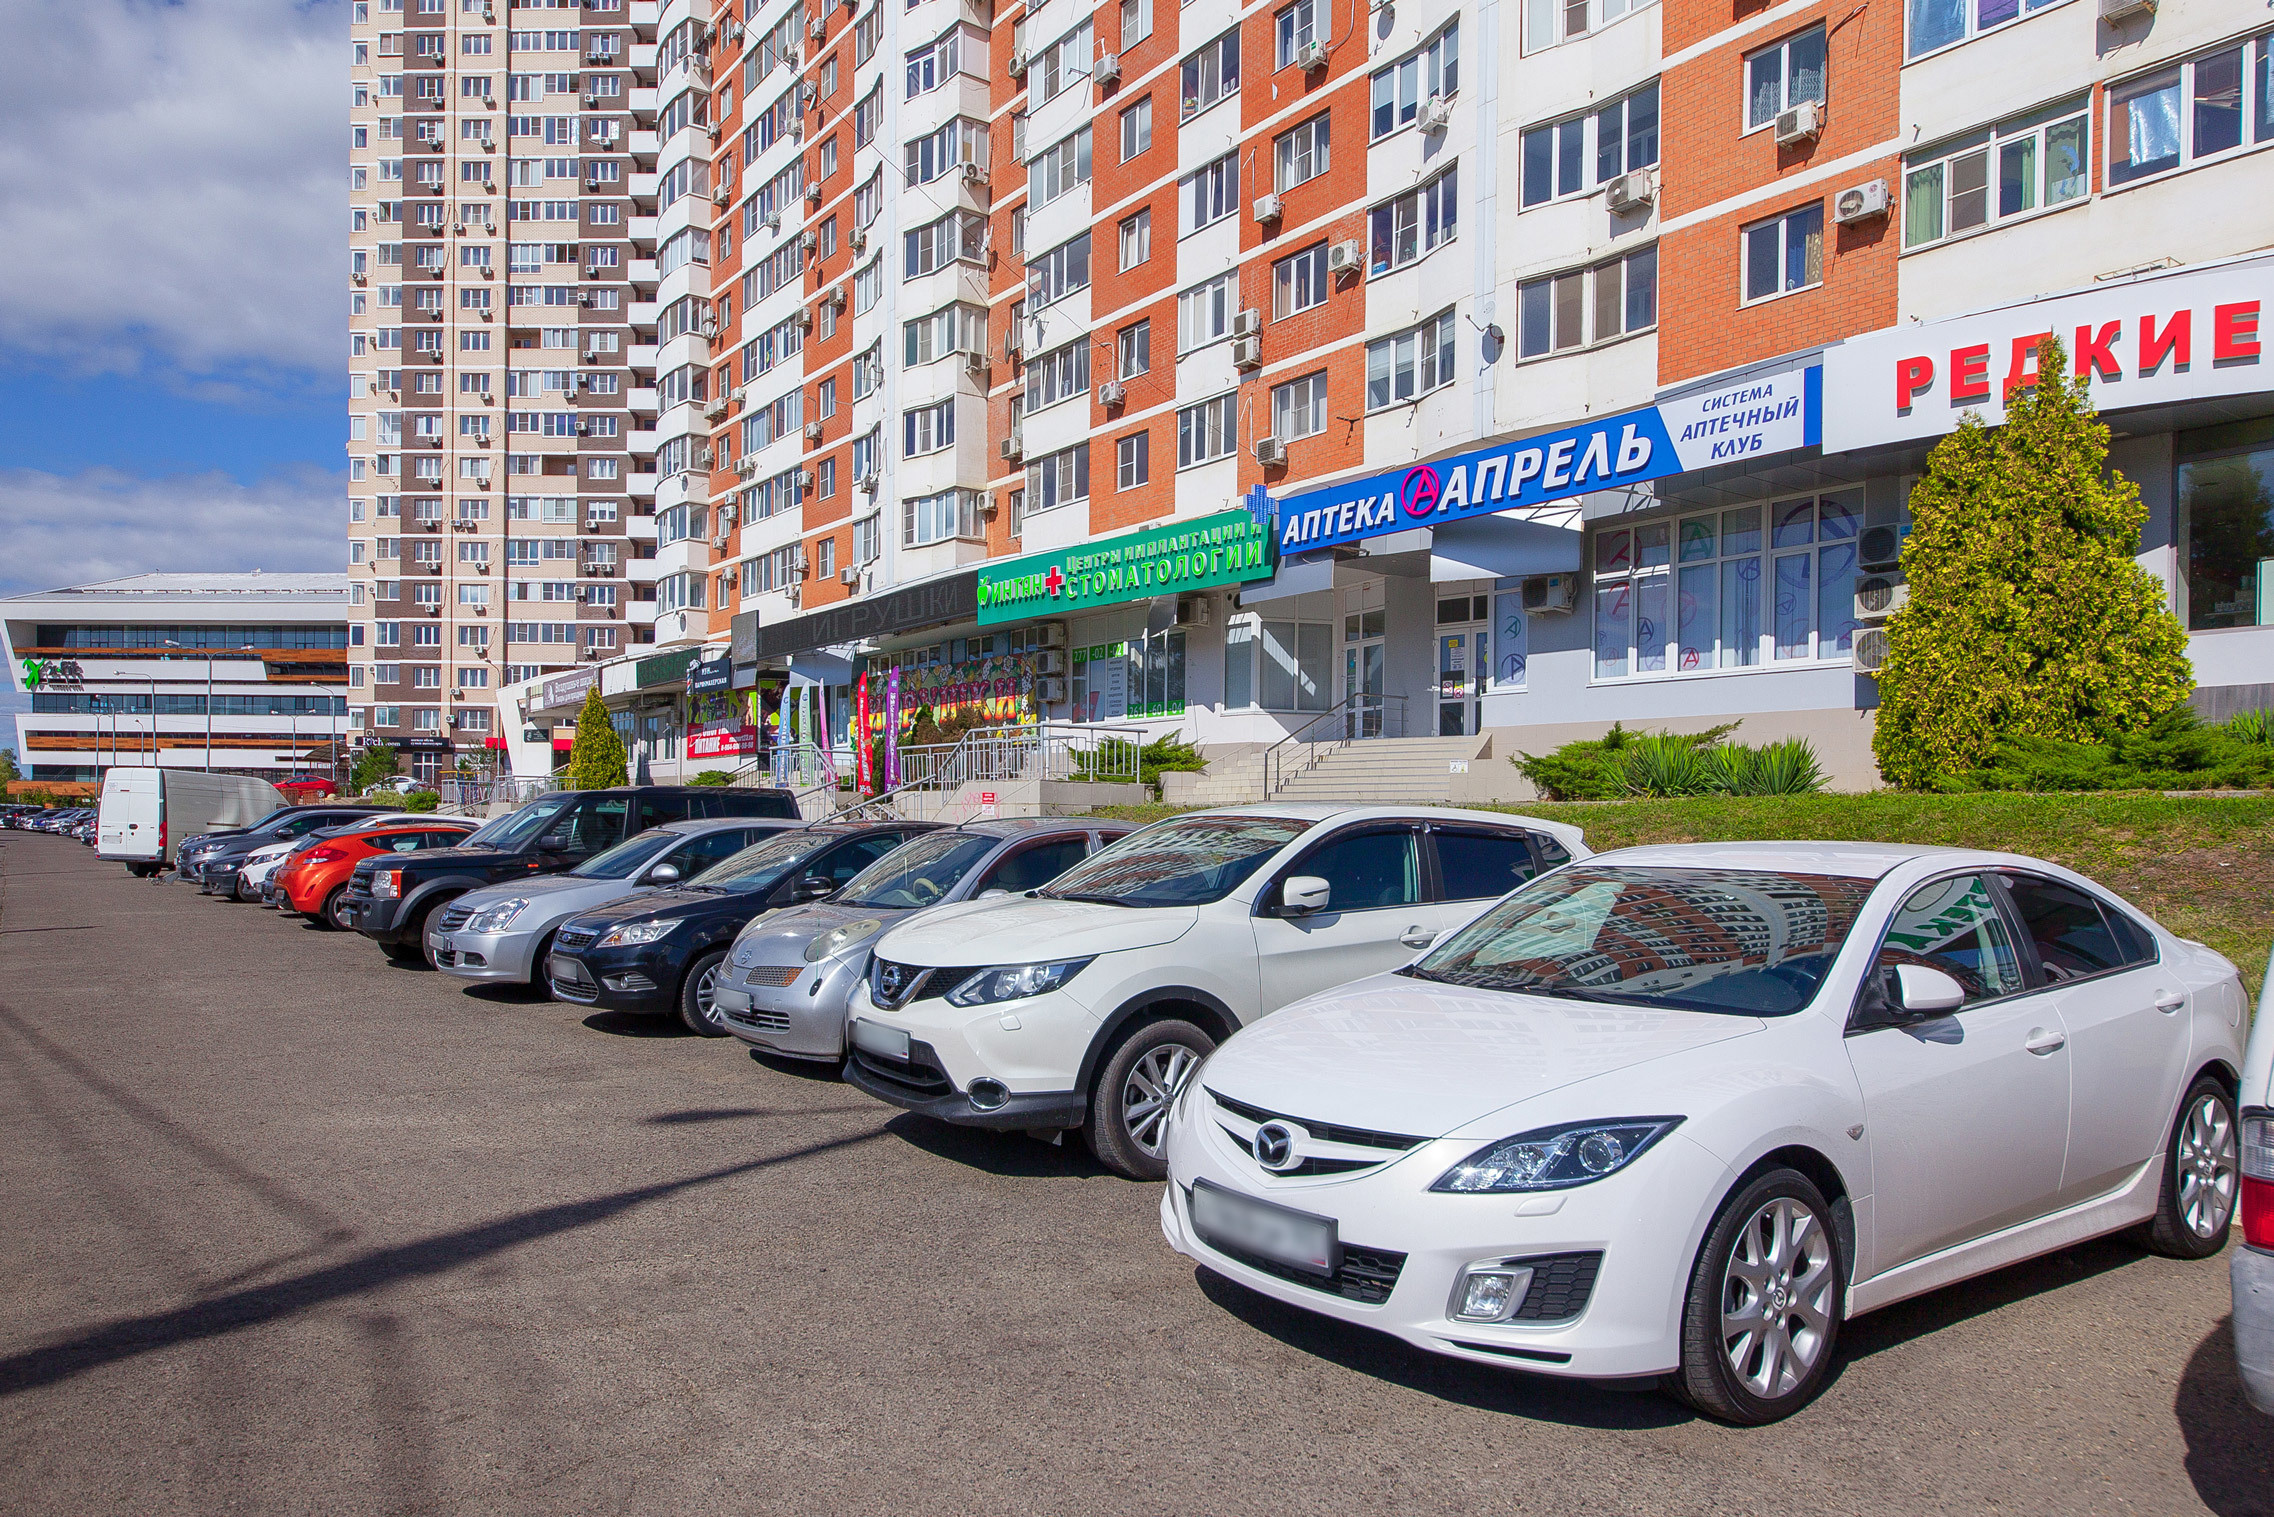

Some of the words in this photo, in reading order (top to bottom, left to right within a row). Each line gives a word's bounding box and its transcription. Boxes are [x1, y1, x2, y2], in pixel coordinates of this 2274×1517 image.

[1896, 300, 2262, 414] РЕДКИЕ
[1680, 396, 1800, 442] АПТЕЧНЫЙ
[1702, 384, 1773, 413] СИСТЕМА
[1711, 433, 1763, 460] КЛУБ
[1282, 492, 1396, 545] АПТЕКА
[1437, 423, 1652, 511] АПРЕЛЬ
[1125, 522, 1246, 561] ИМПЛАНТАЦИИ
[991, 573, 1045, 604] ИНТАН
[1065, 540, 1262, 598] СТОМАТОЛОГИИ
[812, 581, 959, 642] ИГРУШКИ
[1074, 650, 1087, 662] 277
[1092, 647, 1103, 658] -02
[1110, 643, 1122, 656] -02
[867, 676, 1018, 734] ИРУШКИ
[1129, 705, 1143, 718] 261
[1149, 703, 1162, 716] -60
[1168, 701, 1182, 714] -04
